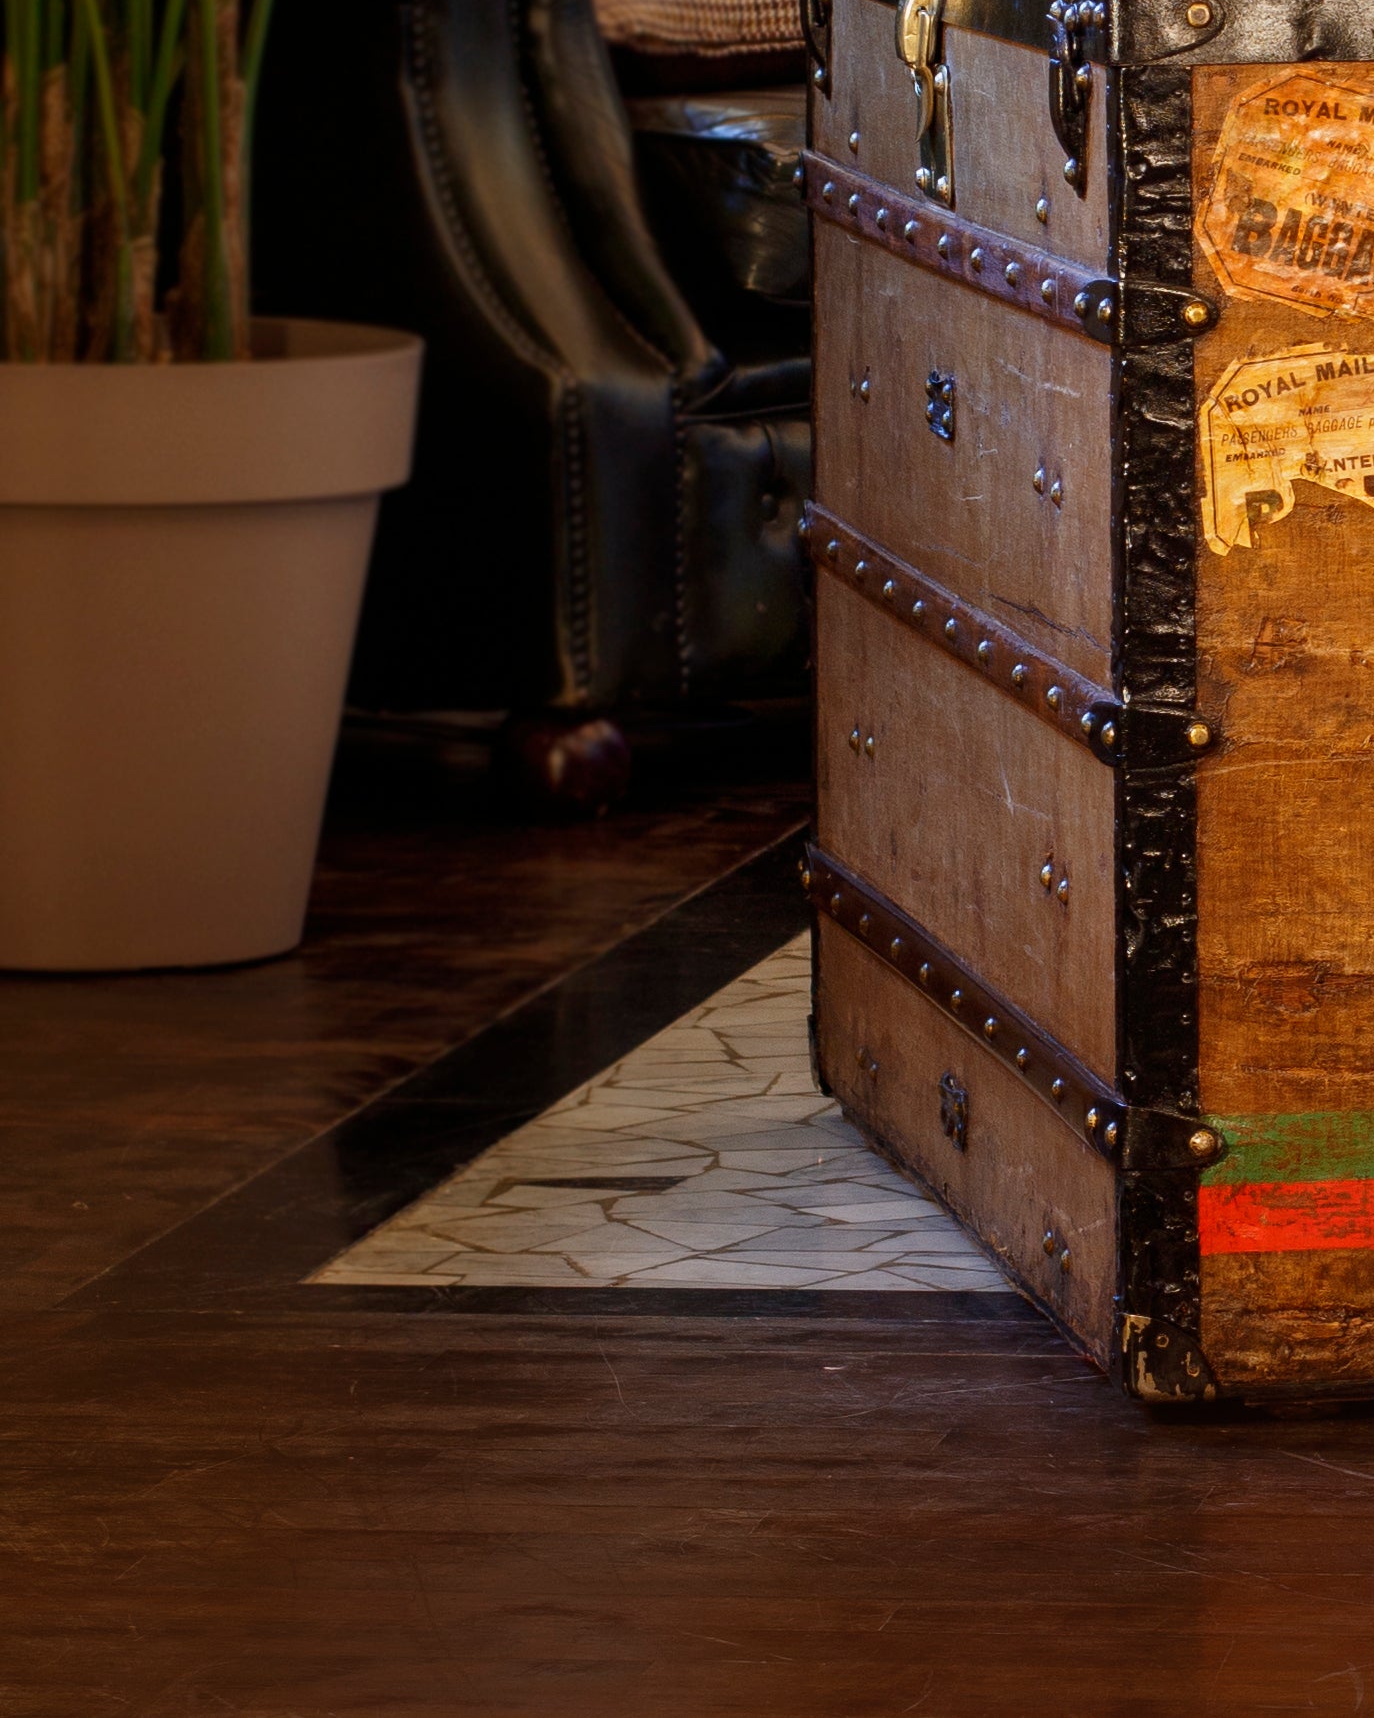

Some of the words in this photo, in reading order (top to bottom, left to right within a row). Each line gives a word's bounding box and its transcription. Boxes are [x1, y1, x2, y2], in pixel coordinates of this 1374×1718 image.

[1262, 97, 1348, 121] ROYAL
[1238, 152, 1302, 177] EMBARKED
[1224, 371, 1306, 413] ROYAL
[1298, 404, 1331, 417] NAME
[1221, 425, 1299, 447] PASSENGERS
[1307, 414, 1363, 435] BAGGAGE
